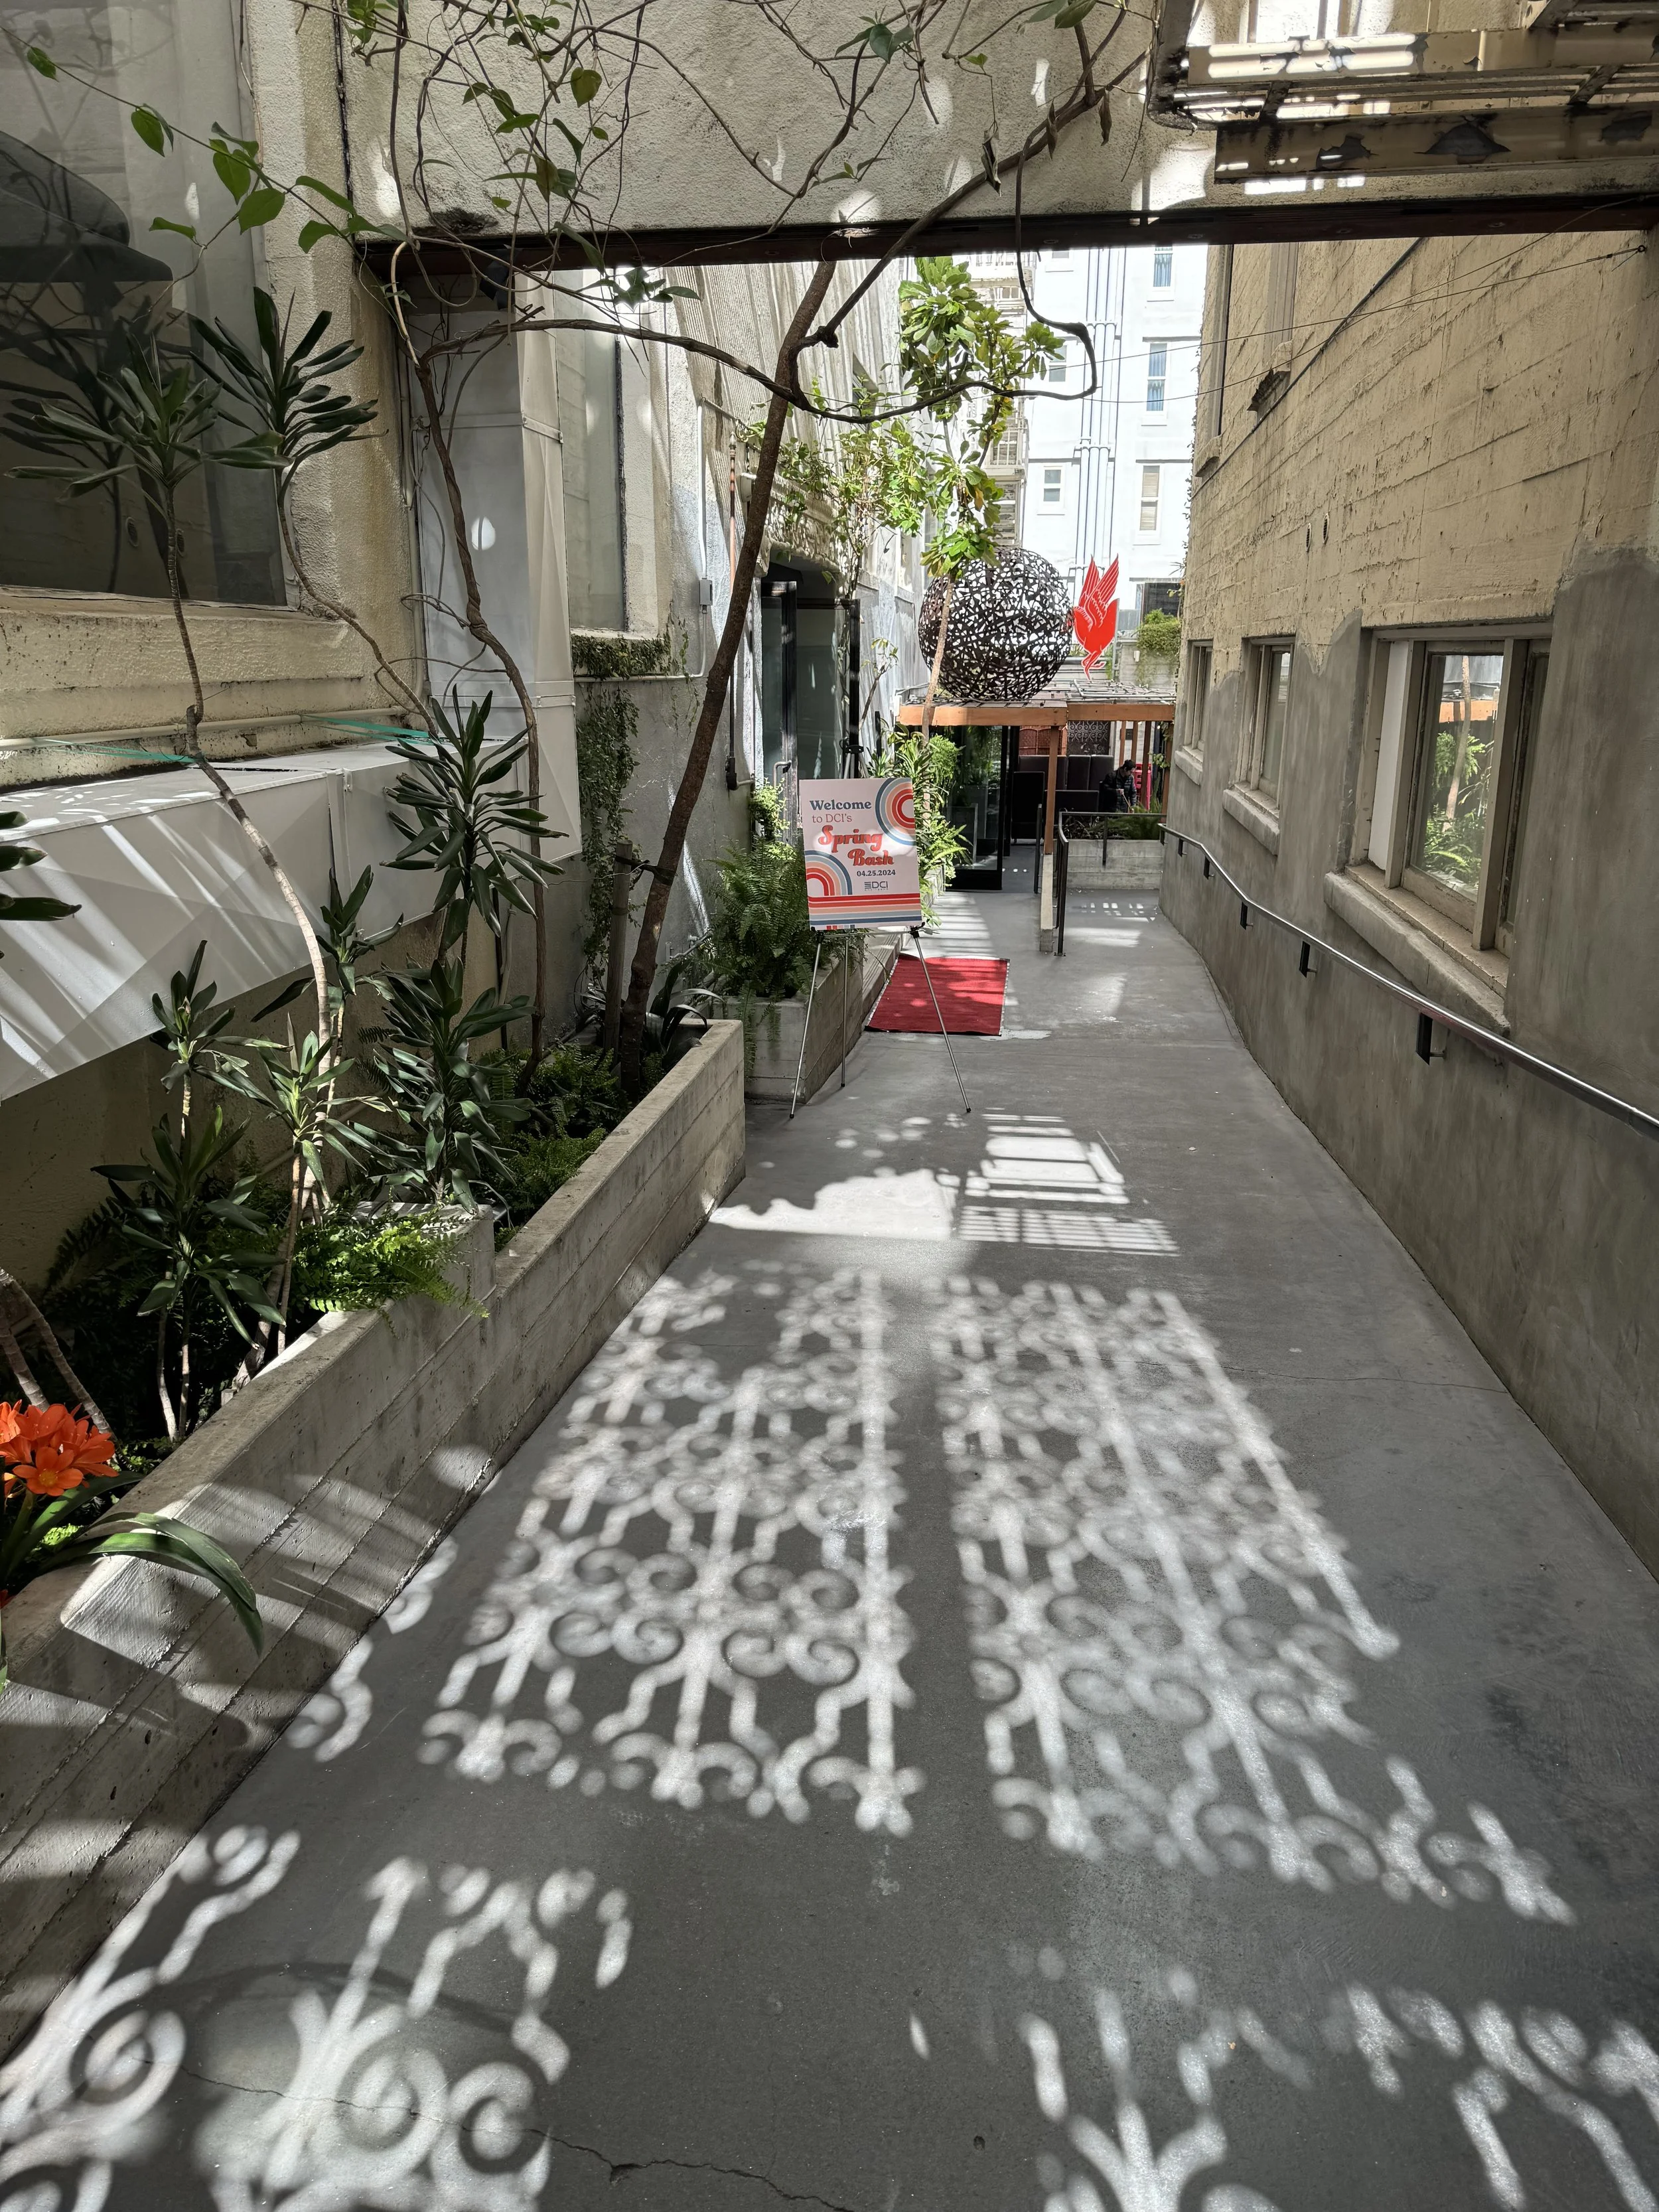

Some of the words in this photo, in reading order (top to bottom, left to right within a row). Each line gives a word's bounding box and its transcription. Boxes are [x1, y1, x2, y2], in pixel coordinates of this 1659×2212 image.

[810, 799, 872, 810] Welcome
[812, 814, 823, 823] to
[826, 813, 852, 823] DCI's
[818, 825, 883, 853] Spring
[847, 849, 895, 866] Bash
